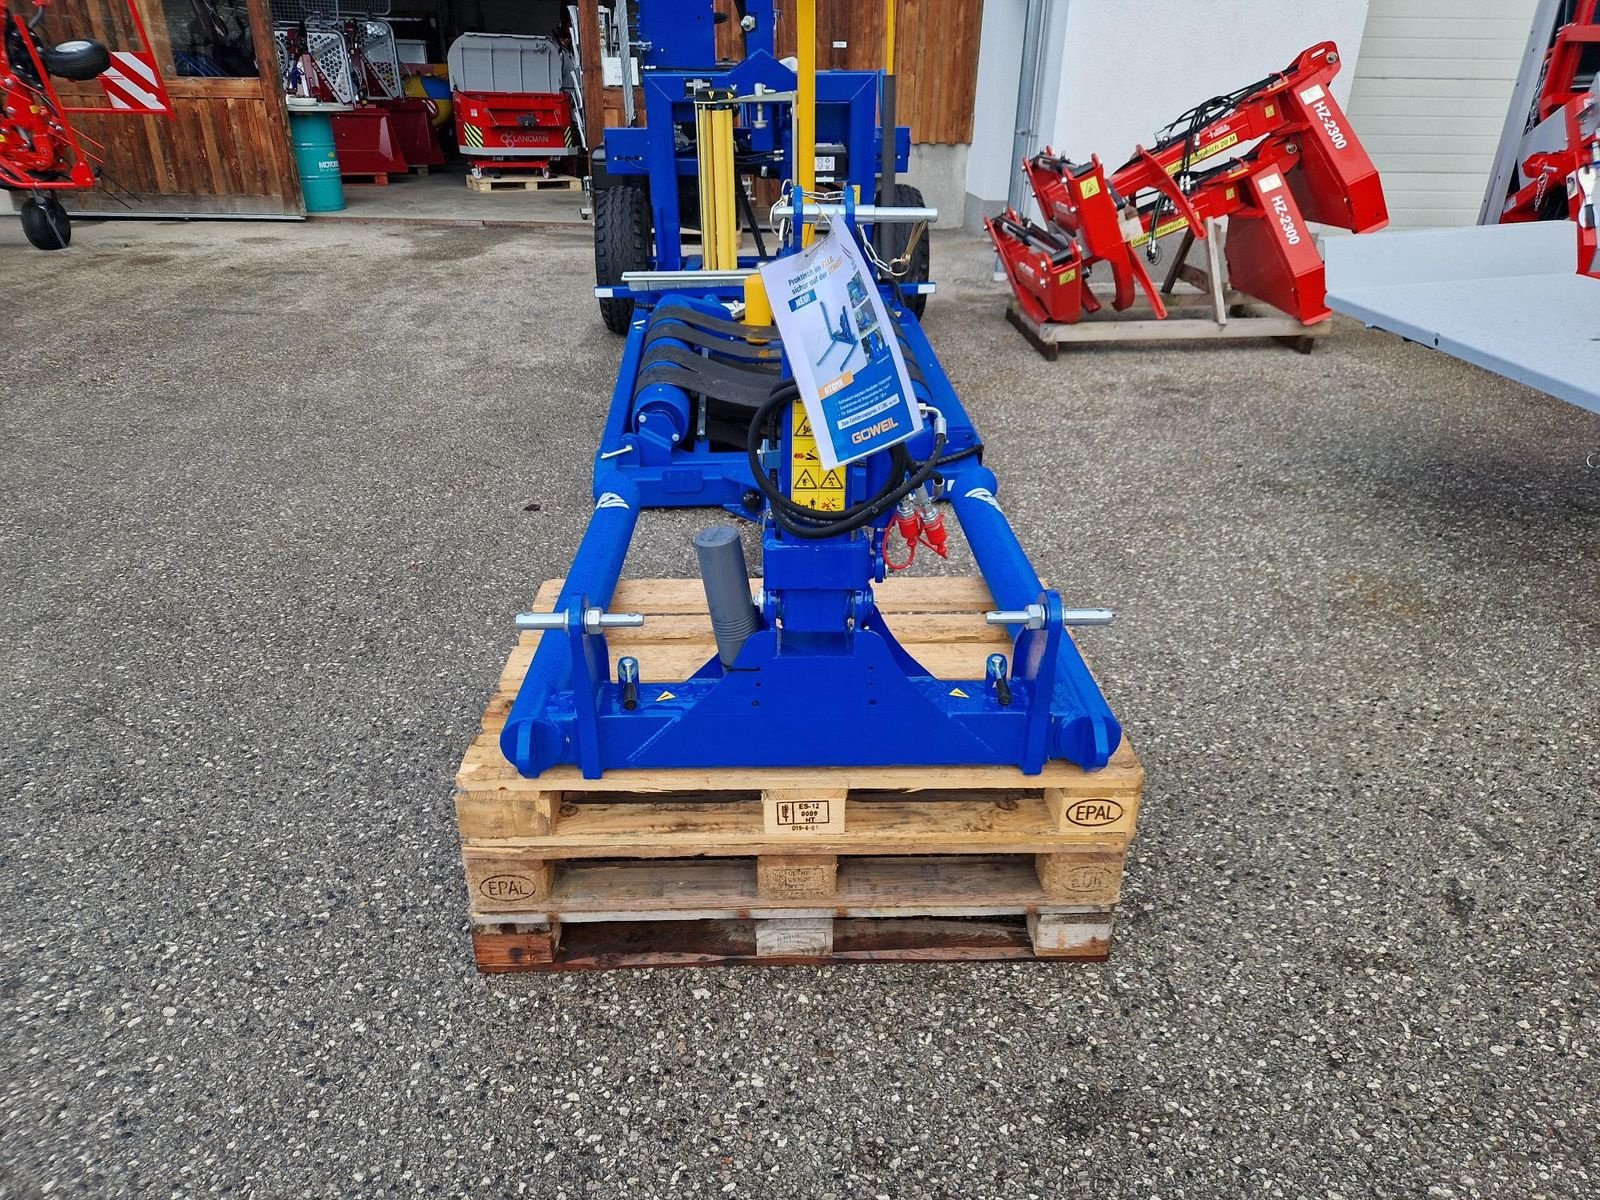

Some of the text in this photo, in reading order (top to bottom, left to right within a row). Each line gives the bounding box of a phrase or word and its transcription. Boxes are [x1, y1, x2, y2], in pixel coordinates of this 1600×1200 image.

[1313, 101, 1347, 149] HZ-2300
[513, 135, 549, 143] LANCMAN
[1271, 195, 1300, 245] HZ-2300
[788, 268, 815, 287] Praktisch
[791, 281, 808, 295] sicher
[809, 275, 819, 286] auf
[819, 271, 828, 281] der
[1075, 805, 1116, 821] EPAL
[488, 880, 529, 896] EPAL
